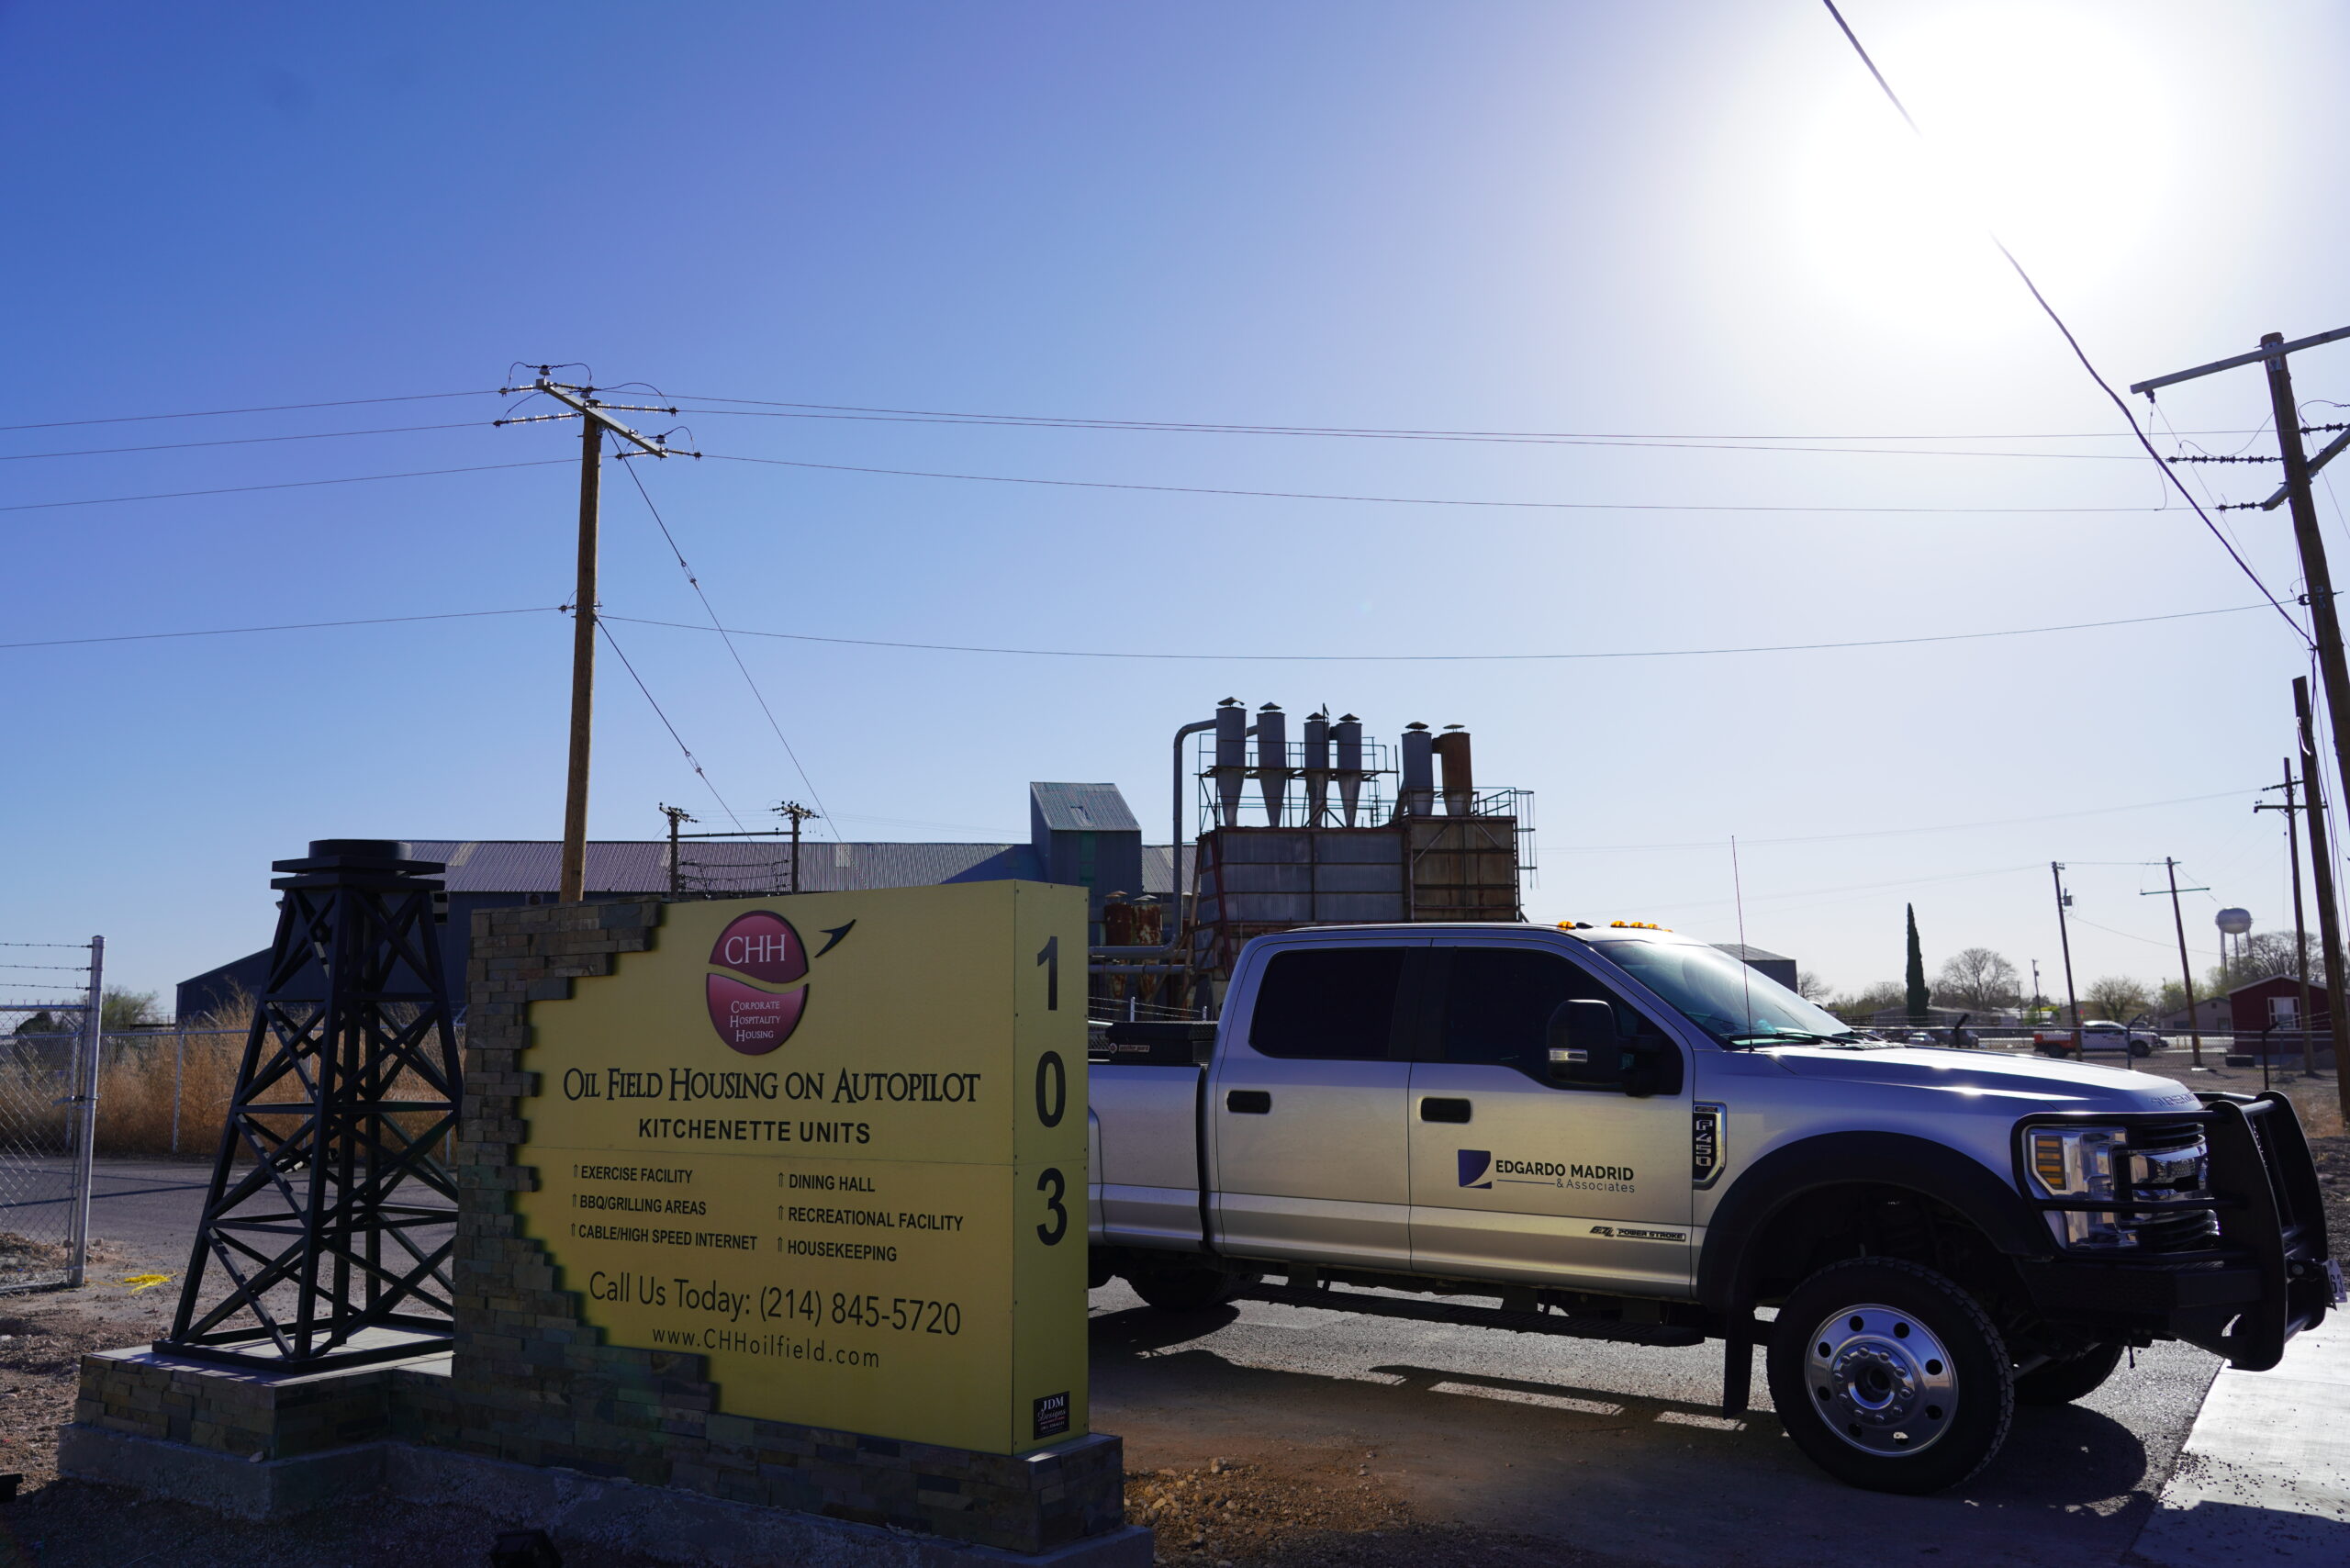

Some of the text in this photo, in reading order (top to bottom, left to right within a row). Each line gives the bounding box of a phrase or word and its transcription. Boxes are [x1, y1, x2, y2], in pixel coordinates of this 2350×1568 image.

[724, 934, 786, 965] CHH
[731, 1001, 780, 1014] CORPORATE
[730, 1015, 781, 1028] HOSPITALITY
[735, 1029, 774, 1042] HOUSING
[564, 1067, 981, 1103] OIL FIELD HOUSING ON AUTOPILOT
[639, 1118, 870, 1144] KITCHENETTE UNITS
[581, 1165, 693, 1183] EXERCISE FACILITY
[1495, 1159, 1634, 1182] EDGARDO MADRID
[789, 1173, 876, 1193] DINING HALL
[1556, 1178, 1635, 1193] & Associates
[579, 1194, 707, 1215] BBQ/GRILLING AREAS
[789, 1206, 964, 1231] RECREATIONAL FACILITY
[578, 1225, 758, 1250] CABLE/HIGH SPEED INTERNET
[1617, 1228, 1648, 1237] POWER
[1649, 1231, 1684, 1239] STROKE
[788, 1239, 897, 1261] HOUSEKEEPING
[589, 1271, 961, 1336] Call Us Today: (214) 845-5720
[653, 1328, 879, 1368] www.CHHoilfield.com
[1041, 1395, 1064, 1412] JDM
